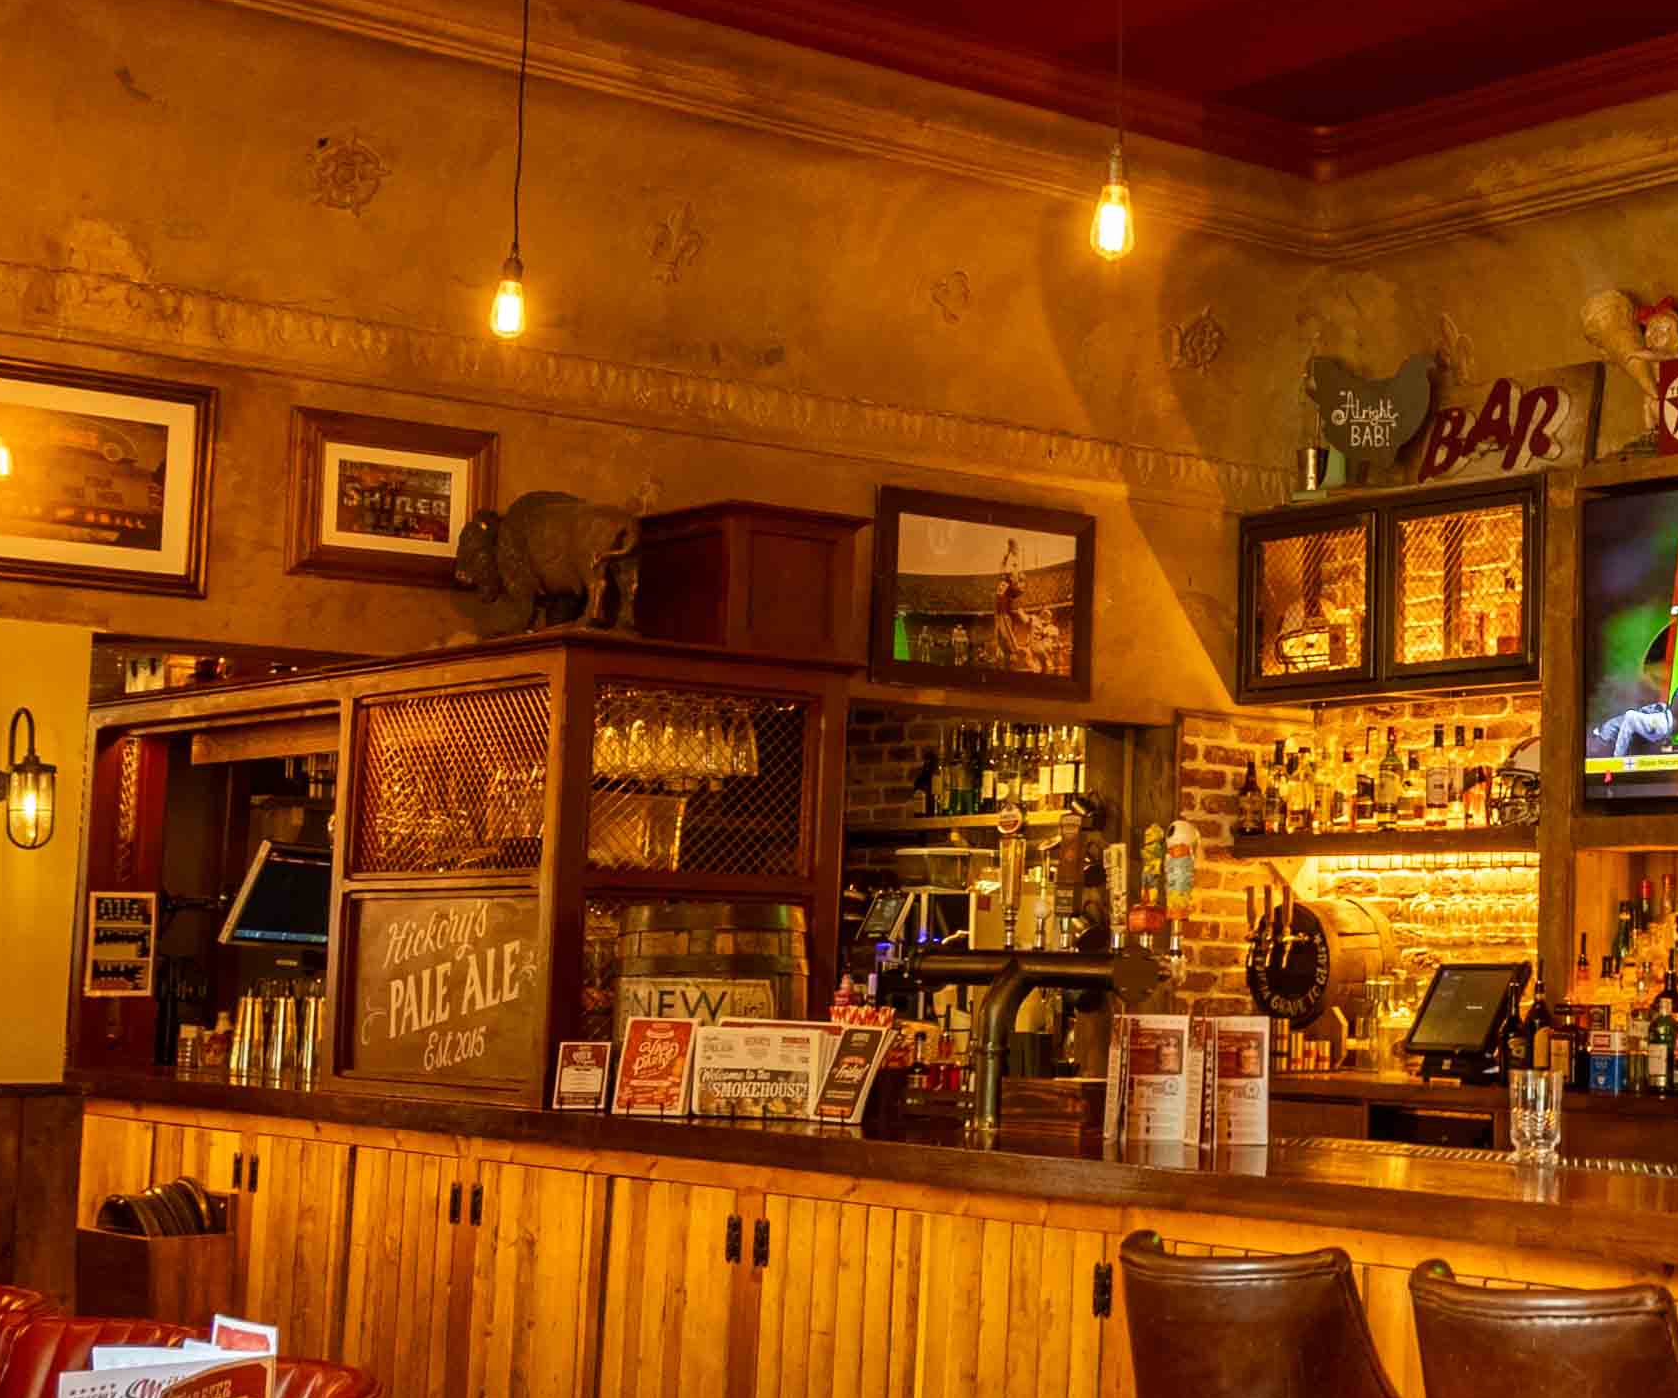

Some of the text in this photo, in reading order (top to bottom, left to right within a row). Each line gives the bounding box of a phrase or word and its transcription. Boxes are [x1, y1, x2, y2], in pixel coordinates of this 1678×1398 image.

[1350, 425, 1390, 447] BAB!
[1418, 378, 1568, 482] BAR
[382, 898, 491, 970] Hickory's
[389, 940, 521, 1039] PALE ALE
[633, 989, 727, 1025] NEW
[455, 1025, 487, 1063] 2015
[711, 1081, 808, 1098] SMOKEHOUSE!
[757, 1067, 770, 1080] the
